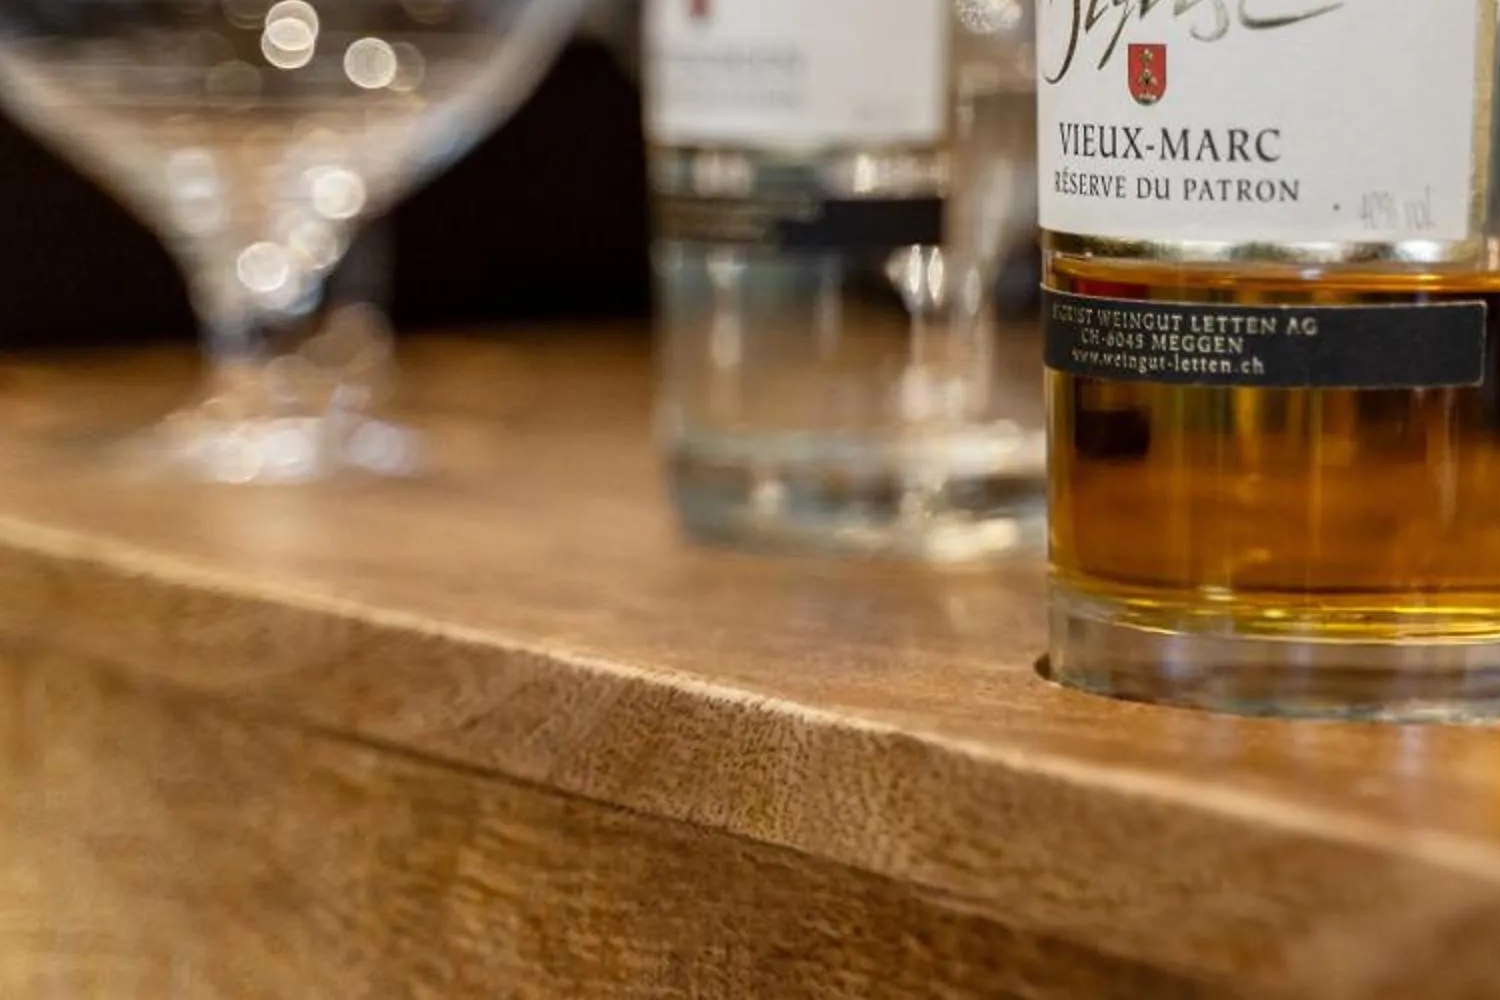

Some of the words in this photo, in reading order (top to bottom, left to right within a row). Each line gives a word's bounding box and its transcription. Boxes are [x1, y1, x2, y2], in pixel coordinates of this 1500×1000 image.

[1058, 122, 1282, 163] VIEUX-MARC
[1054, 170, 1127, 200] RÉSERVE
[1137, 177, 1171, 201] DU
[1184, 178, 1301, 203] PATRON
[1096, 308, 1183, 332] WEINGUT
[1191, 314, 1278, 335] LETTEN
[1286, 316, 1320, 336] AG
[1081, 327, 1145, 349] CH-6045
[1151, 332, 1245, 353] MEGGEN
